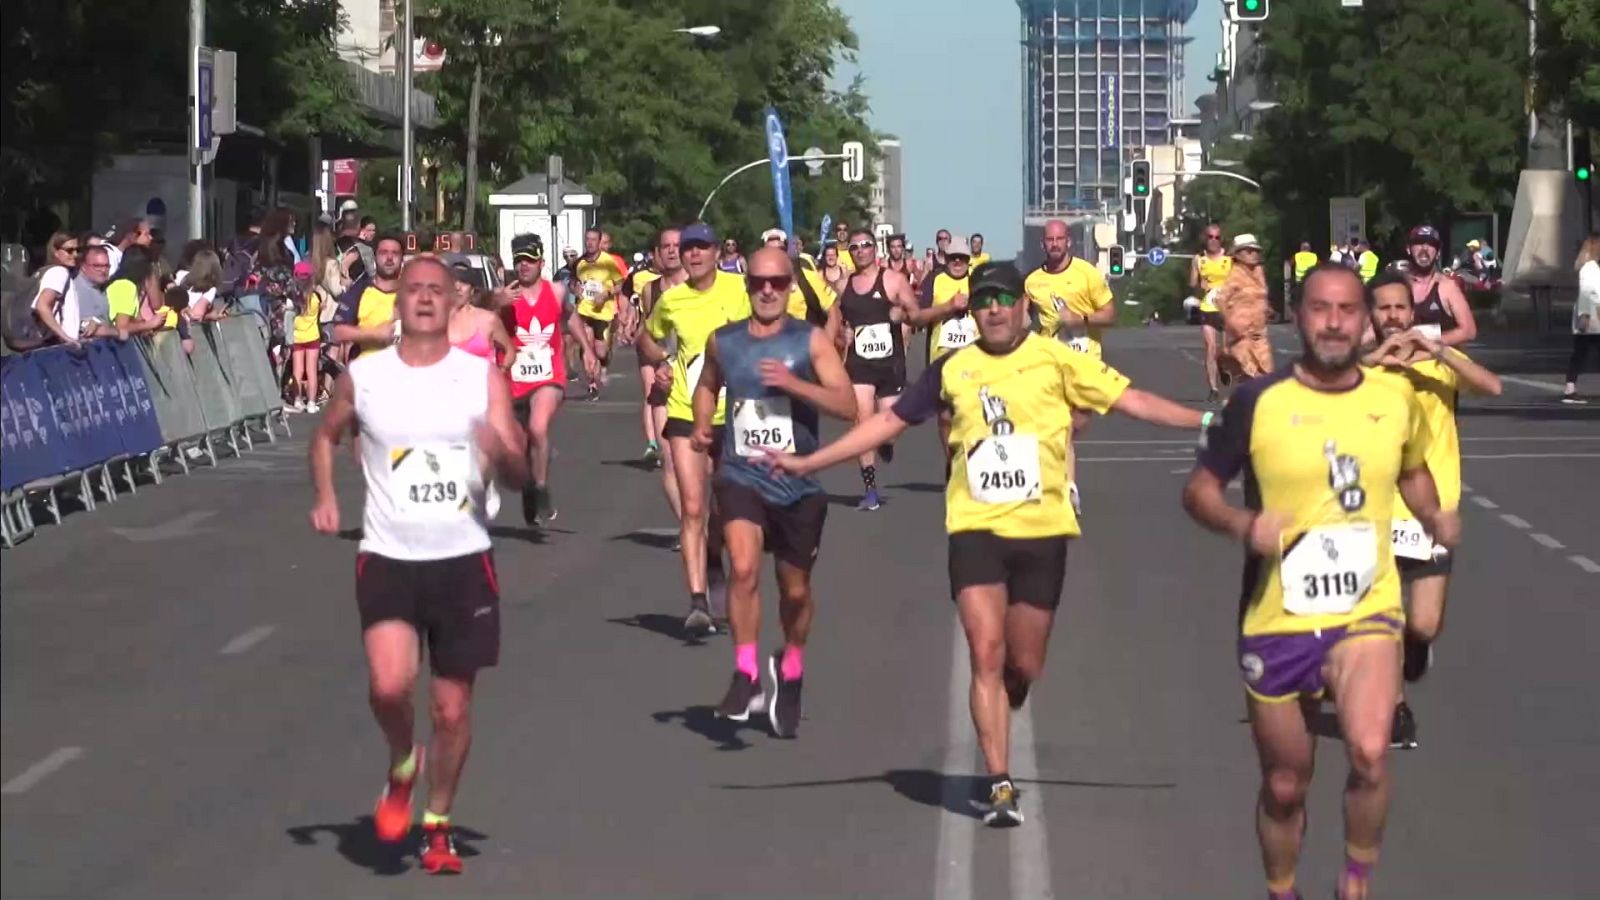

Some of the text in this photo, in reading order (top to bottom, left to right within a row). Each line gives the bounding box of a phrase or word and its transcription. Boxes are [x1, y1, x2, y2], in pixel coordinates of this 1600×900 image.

[520, 363, 543, 376] 3731
[743, 427, 782, 446] 2526
[979, 469, 1027, 491] 2456
[408, 480, 458, 504] 4239
[1303, 571, 1359, 599] 3119
